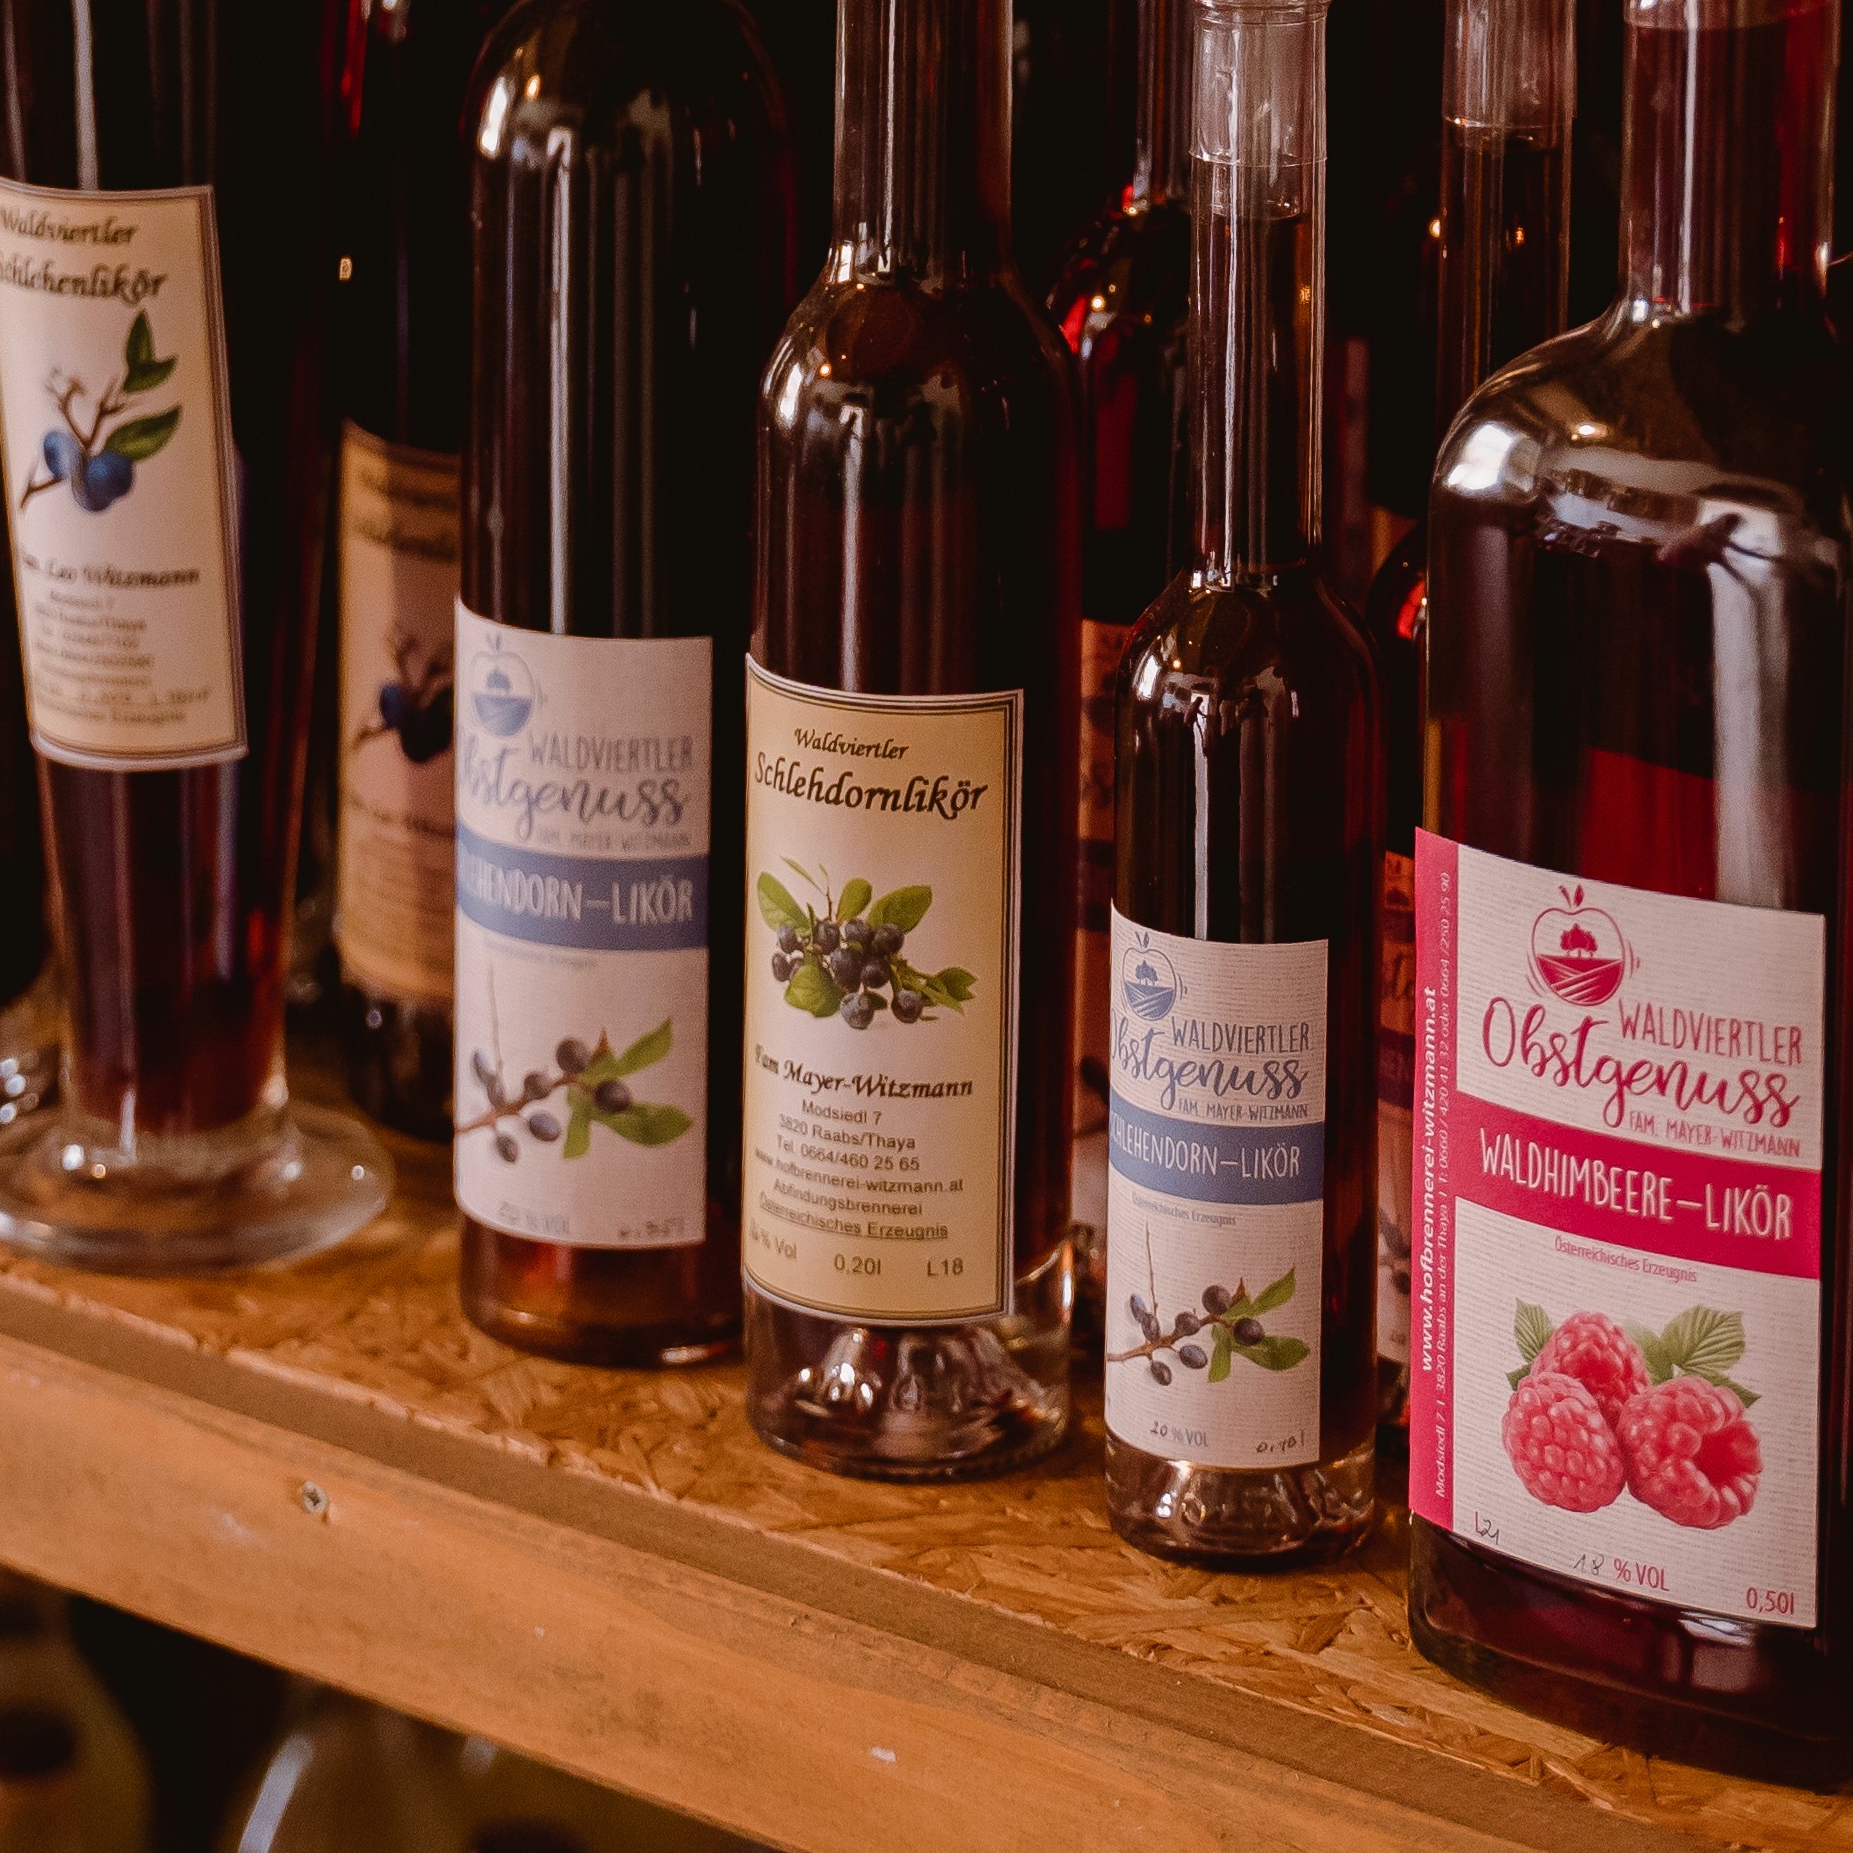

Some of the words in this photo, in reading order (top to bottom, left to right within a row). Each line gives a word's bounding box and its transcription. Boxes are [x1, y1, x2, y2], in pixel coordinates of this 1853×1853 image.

[0, 208, 140, 244] Waldviertler
[529, 730, 694, 774] WALDVIERTLER
[794, 728, 909, 760] Waldviertler
[755, 751, 988, 821] Schlehdornlikör
[1171, 1015, 1310, 1054] WALDVIERTLER
[1439, 1004, 1449, 1038] oder
[1618, 998, 1803, 1066] WALDVIERTLER
[784, 1058, 973, 1098] Mayer-Witzmann
[1482, 995, 1800, 1128] Obstgenuss
[802, 1099, 867, 1124] Modsiedl
[873, 1110, 883, 1126] 7
[812, 1123, 916, 1152] Raabs/Thaya
[1629, 1110, 1657, 1134] FAM.
[1666, 1118, 1801, 1158] MAYER-WITZMANN
[874, 1155, 893, 1172] 25
[899, 1156, 920, 1172] 65
[1420, 985, 1437, 1372] www.hofbrennerei-witzmann.at
[1479, 1126, 1794, 1241] WALDHIMBEERE-LIKÖR
[773, 1177, 923, 1217] Abfindungsbrennerei
[867, 1221, 948, 1240] Erzeugnis
[1437, 1203, 1450, 1249] Thaya
[1437, 1254, 1447, 1279] der
[1555, 1235, 1639, 1271] Österreichisches
[1642, 1257, 1698, 1284] Erzeugnis
[1438, 1282, 1447, 1304] an
[1437, 1305, 1447, 1352] Raabs
[1436, 1354, 1447, 1395] 3820
[1185, 1429, 1209, 1448] VOL
[1435, 1426, 1447, 1498] Modsiedl
[1613, 1558, 1631, 1582] %
[1635, 1562, 1670, 1592] VOL
[1746, 1587, 1795, 1616] 0,50l
